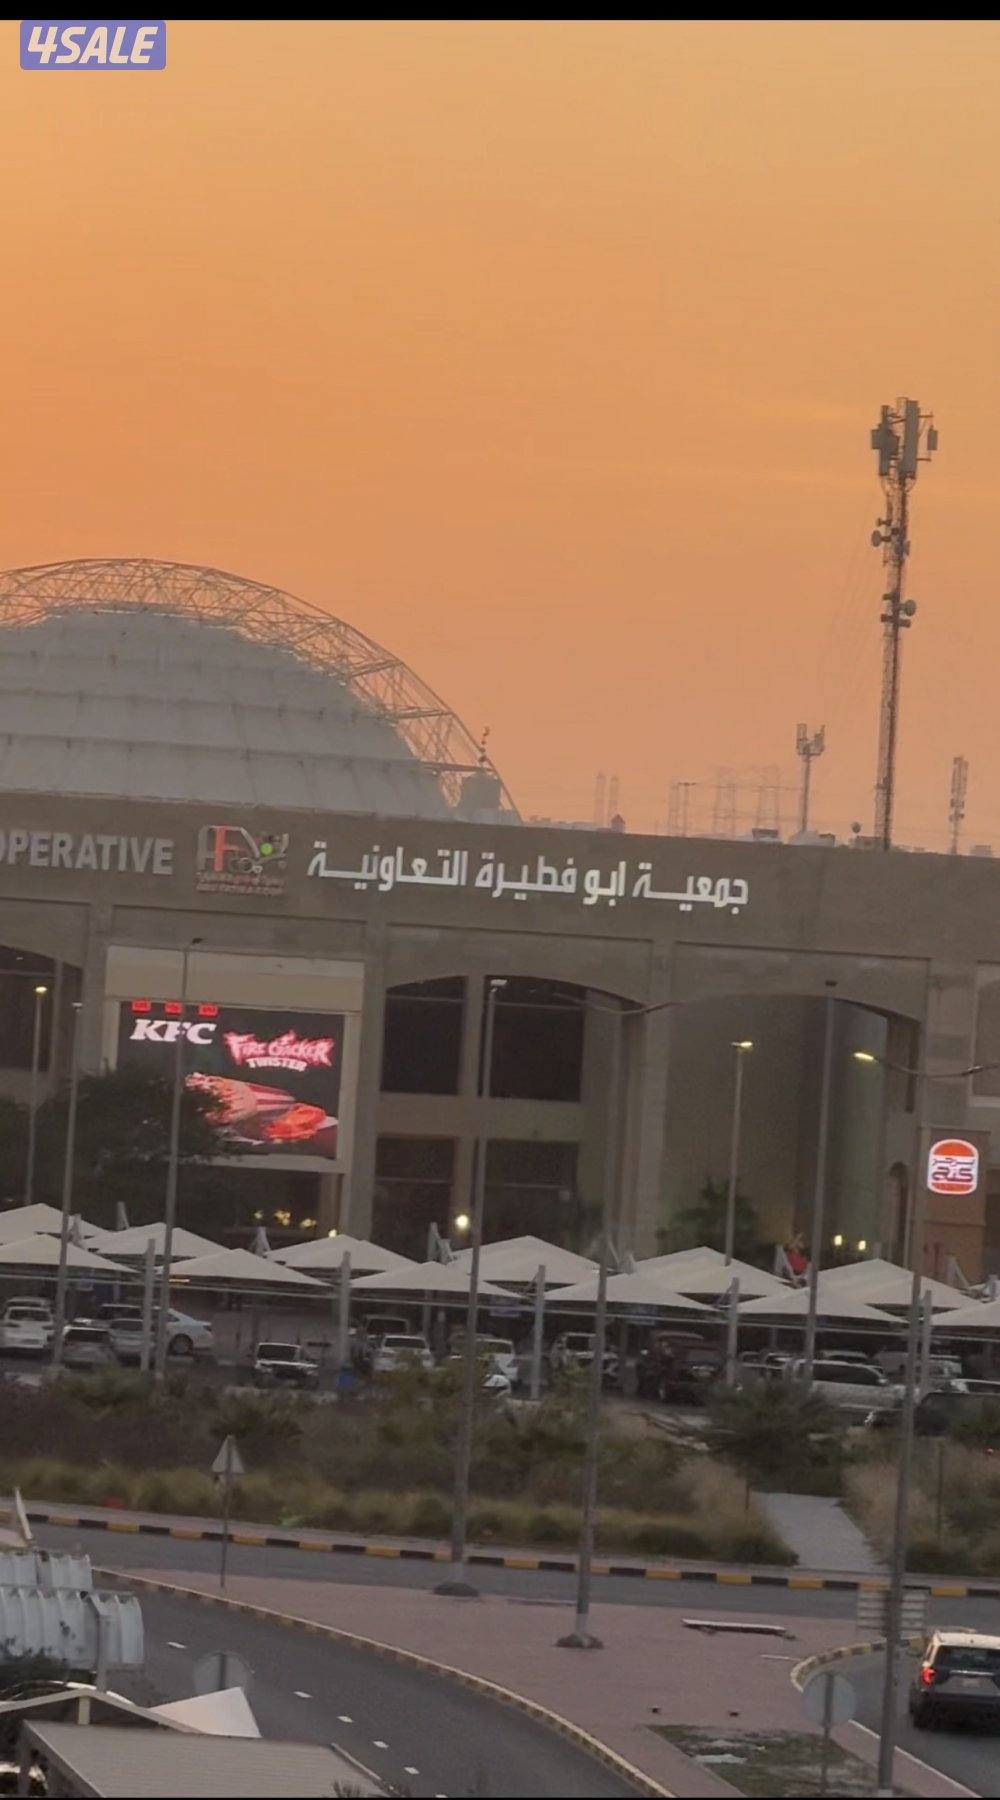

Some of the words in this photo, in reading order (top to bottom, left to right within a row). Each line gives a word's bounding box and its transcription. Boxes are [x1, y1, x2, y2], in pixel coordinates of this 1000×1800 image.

[0, 829, 174, 875] PERATIVE
[307, 841, 468, 891] التعاونية
[474, 852, 578, 899] فطيرة
[632, 863, 748, 914] جمعية
[129, 1019, 217, 1045] KFC
